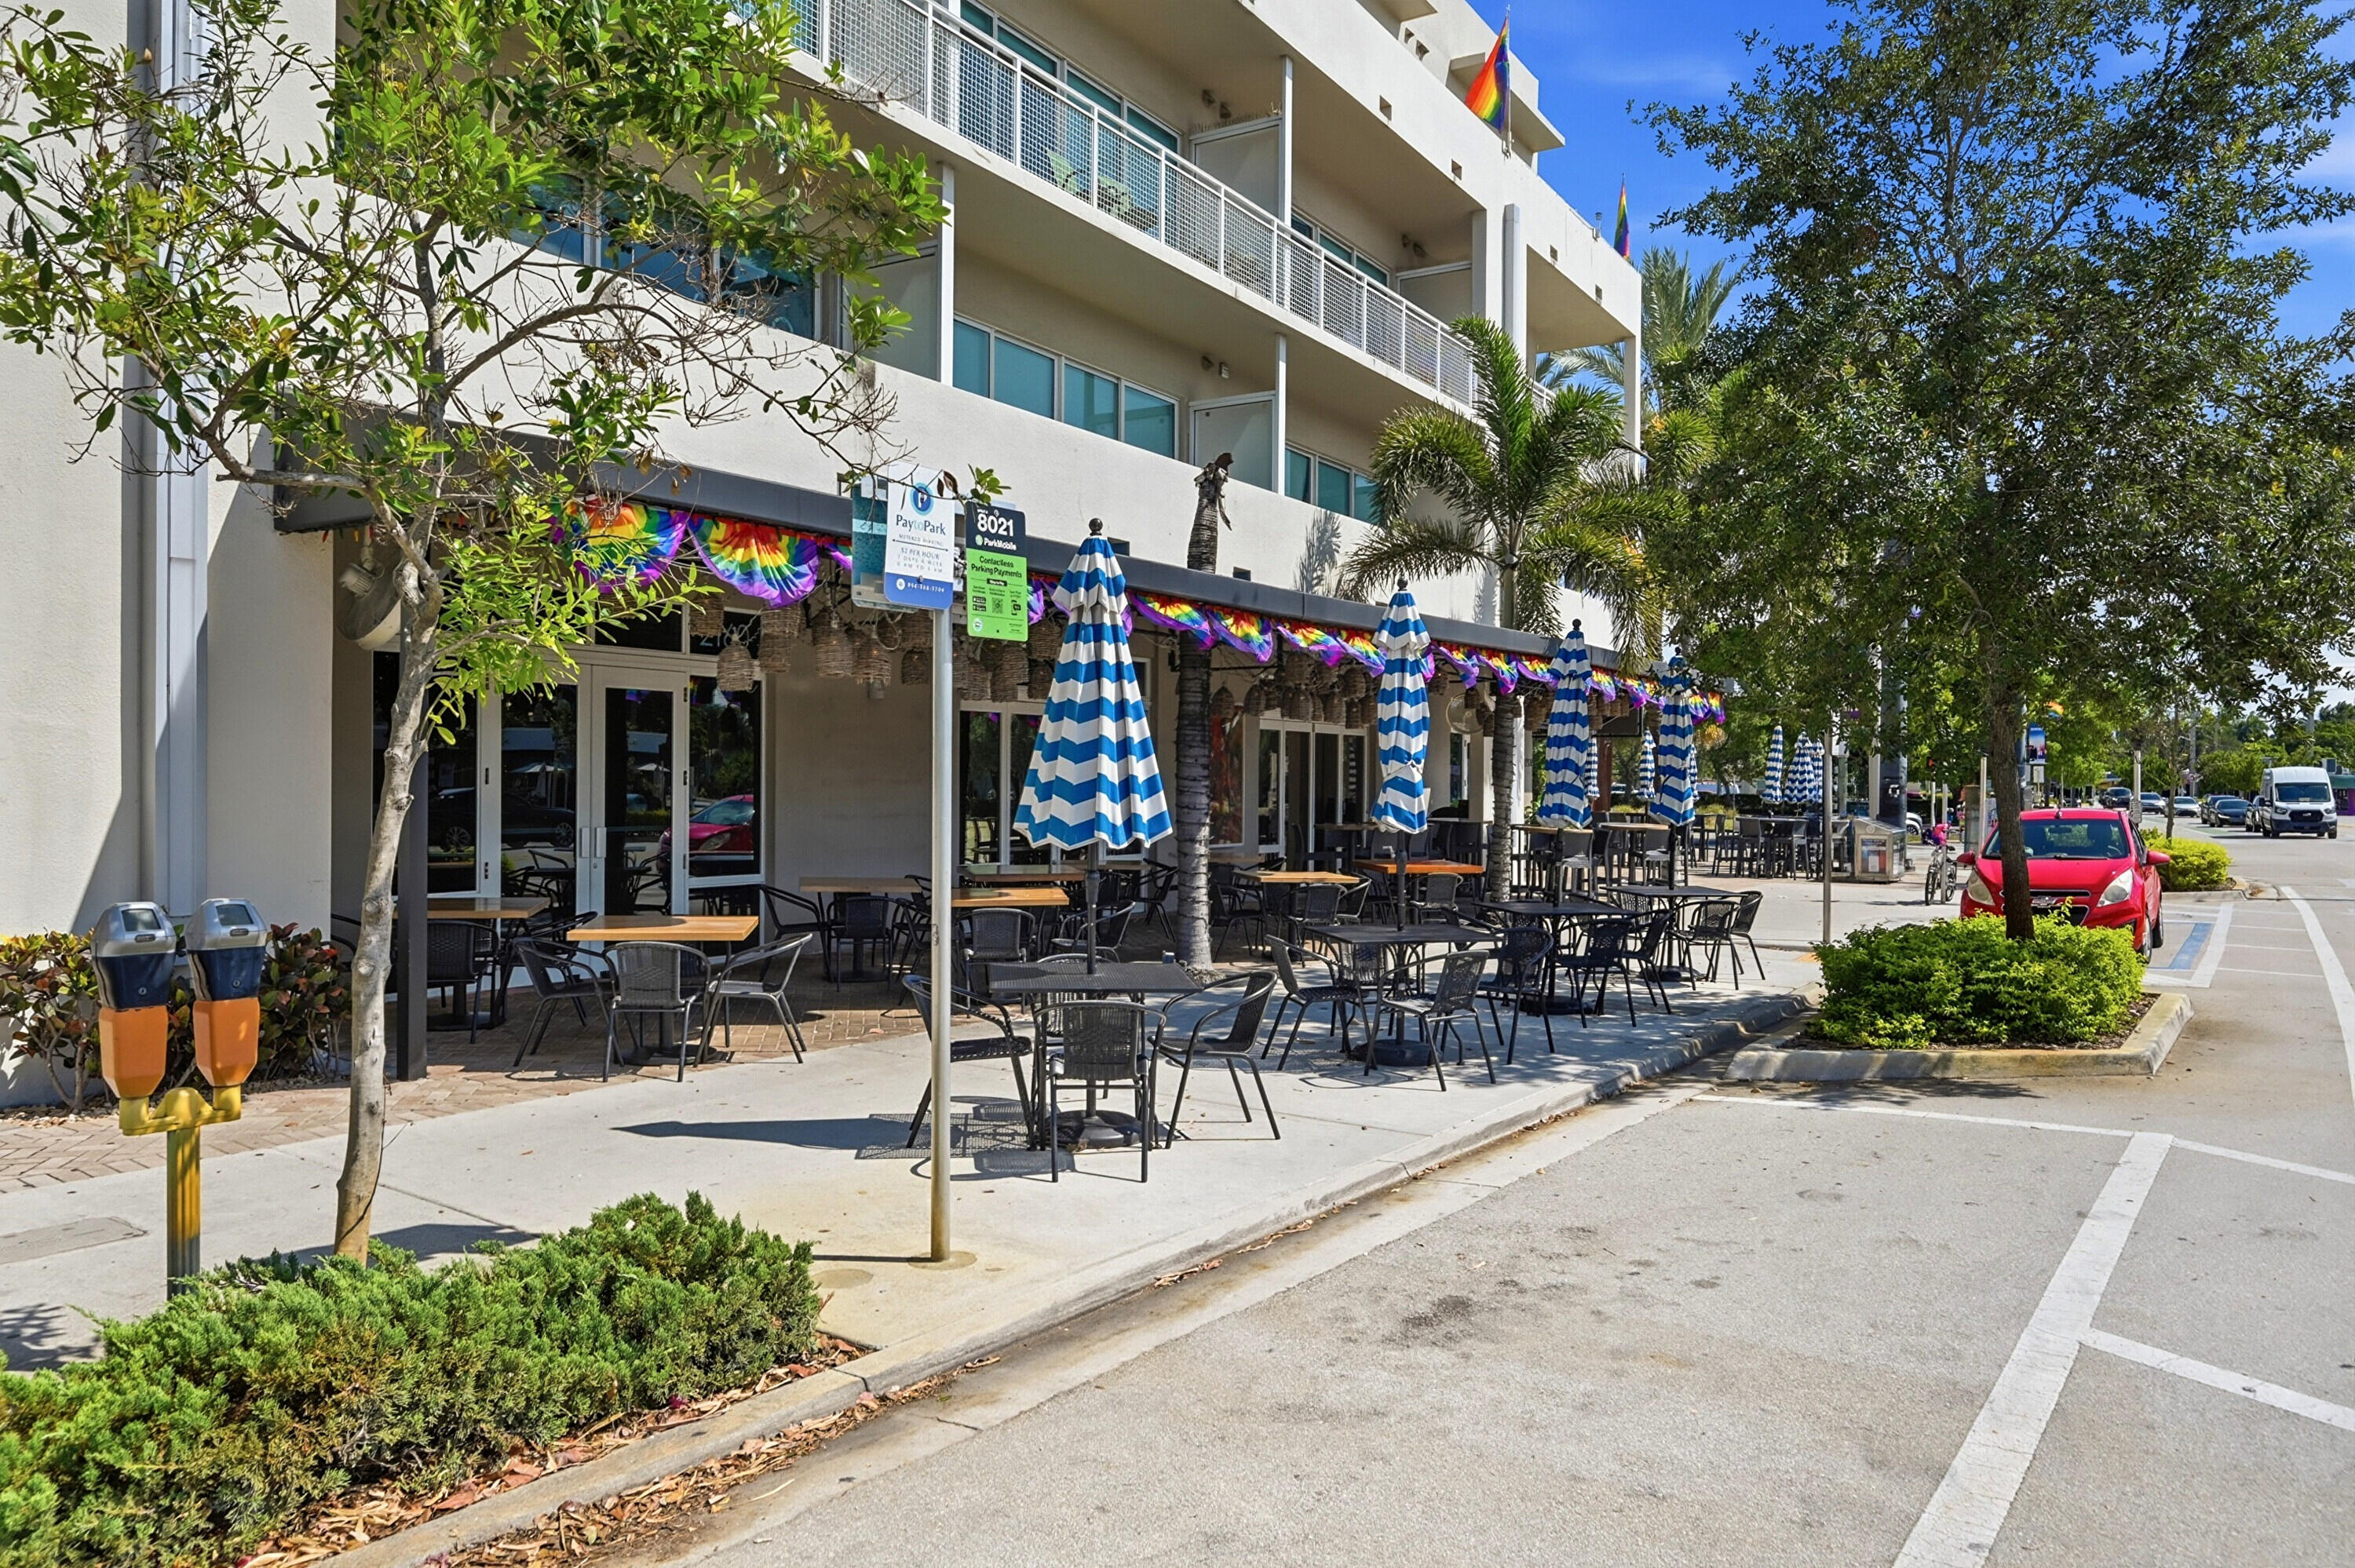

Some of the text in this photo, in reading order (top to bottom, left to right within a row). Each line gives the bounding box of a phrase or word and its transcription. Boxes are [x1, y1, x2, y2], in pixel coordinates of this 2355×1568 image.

[977, 513, 1013, 537] 8021
[984, 537, 1017, 551] ParkMobile
[922, 551, 940, 560] HOUR
[979, 555, 1014, 567] Contactless
[971, 563, 1022, 578] Parking Payments
